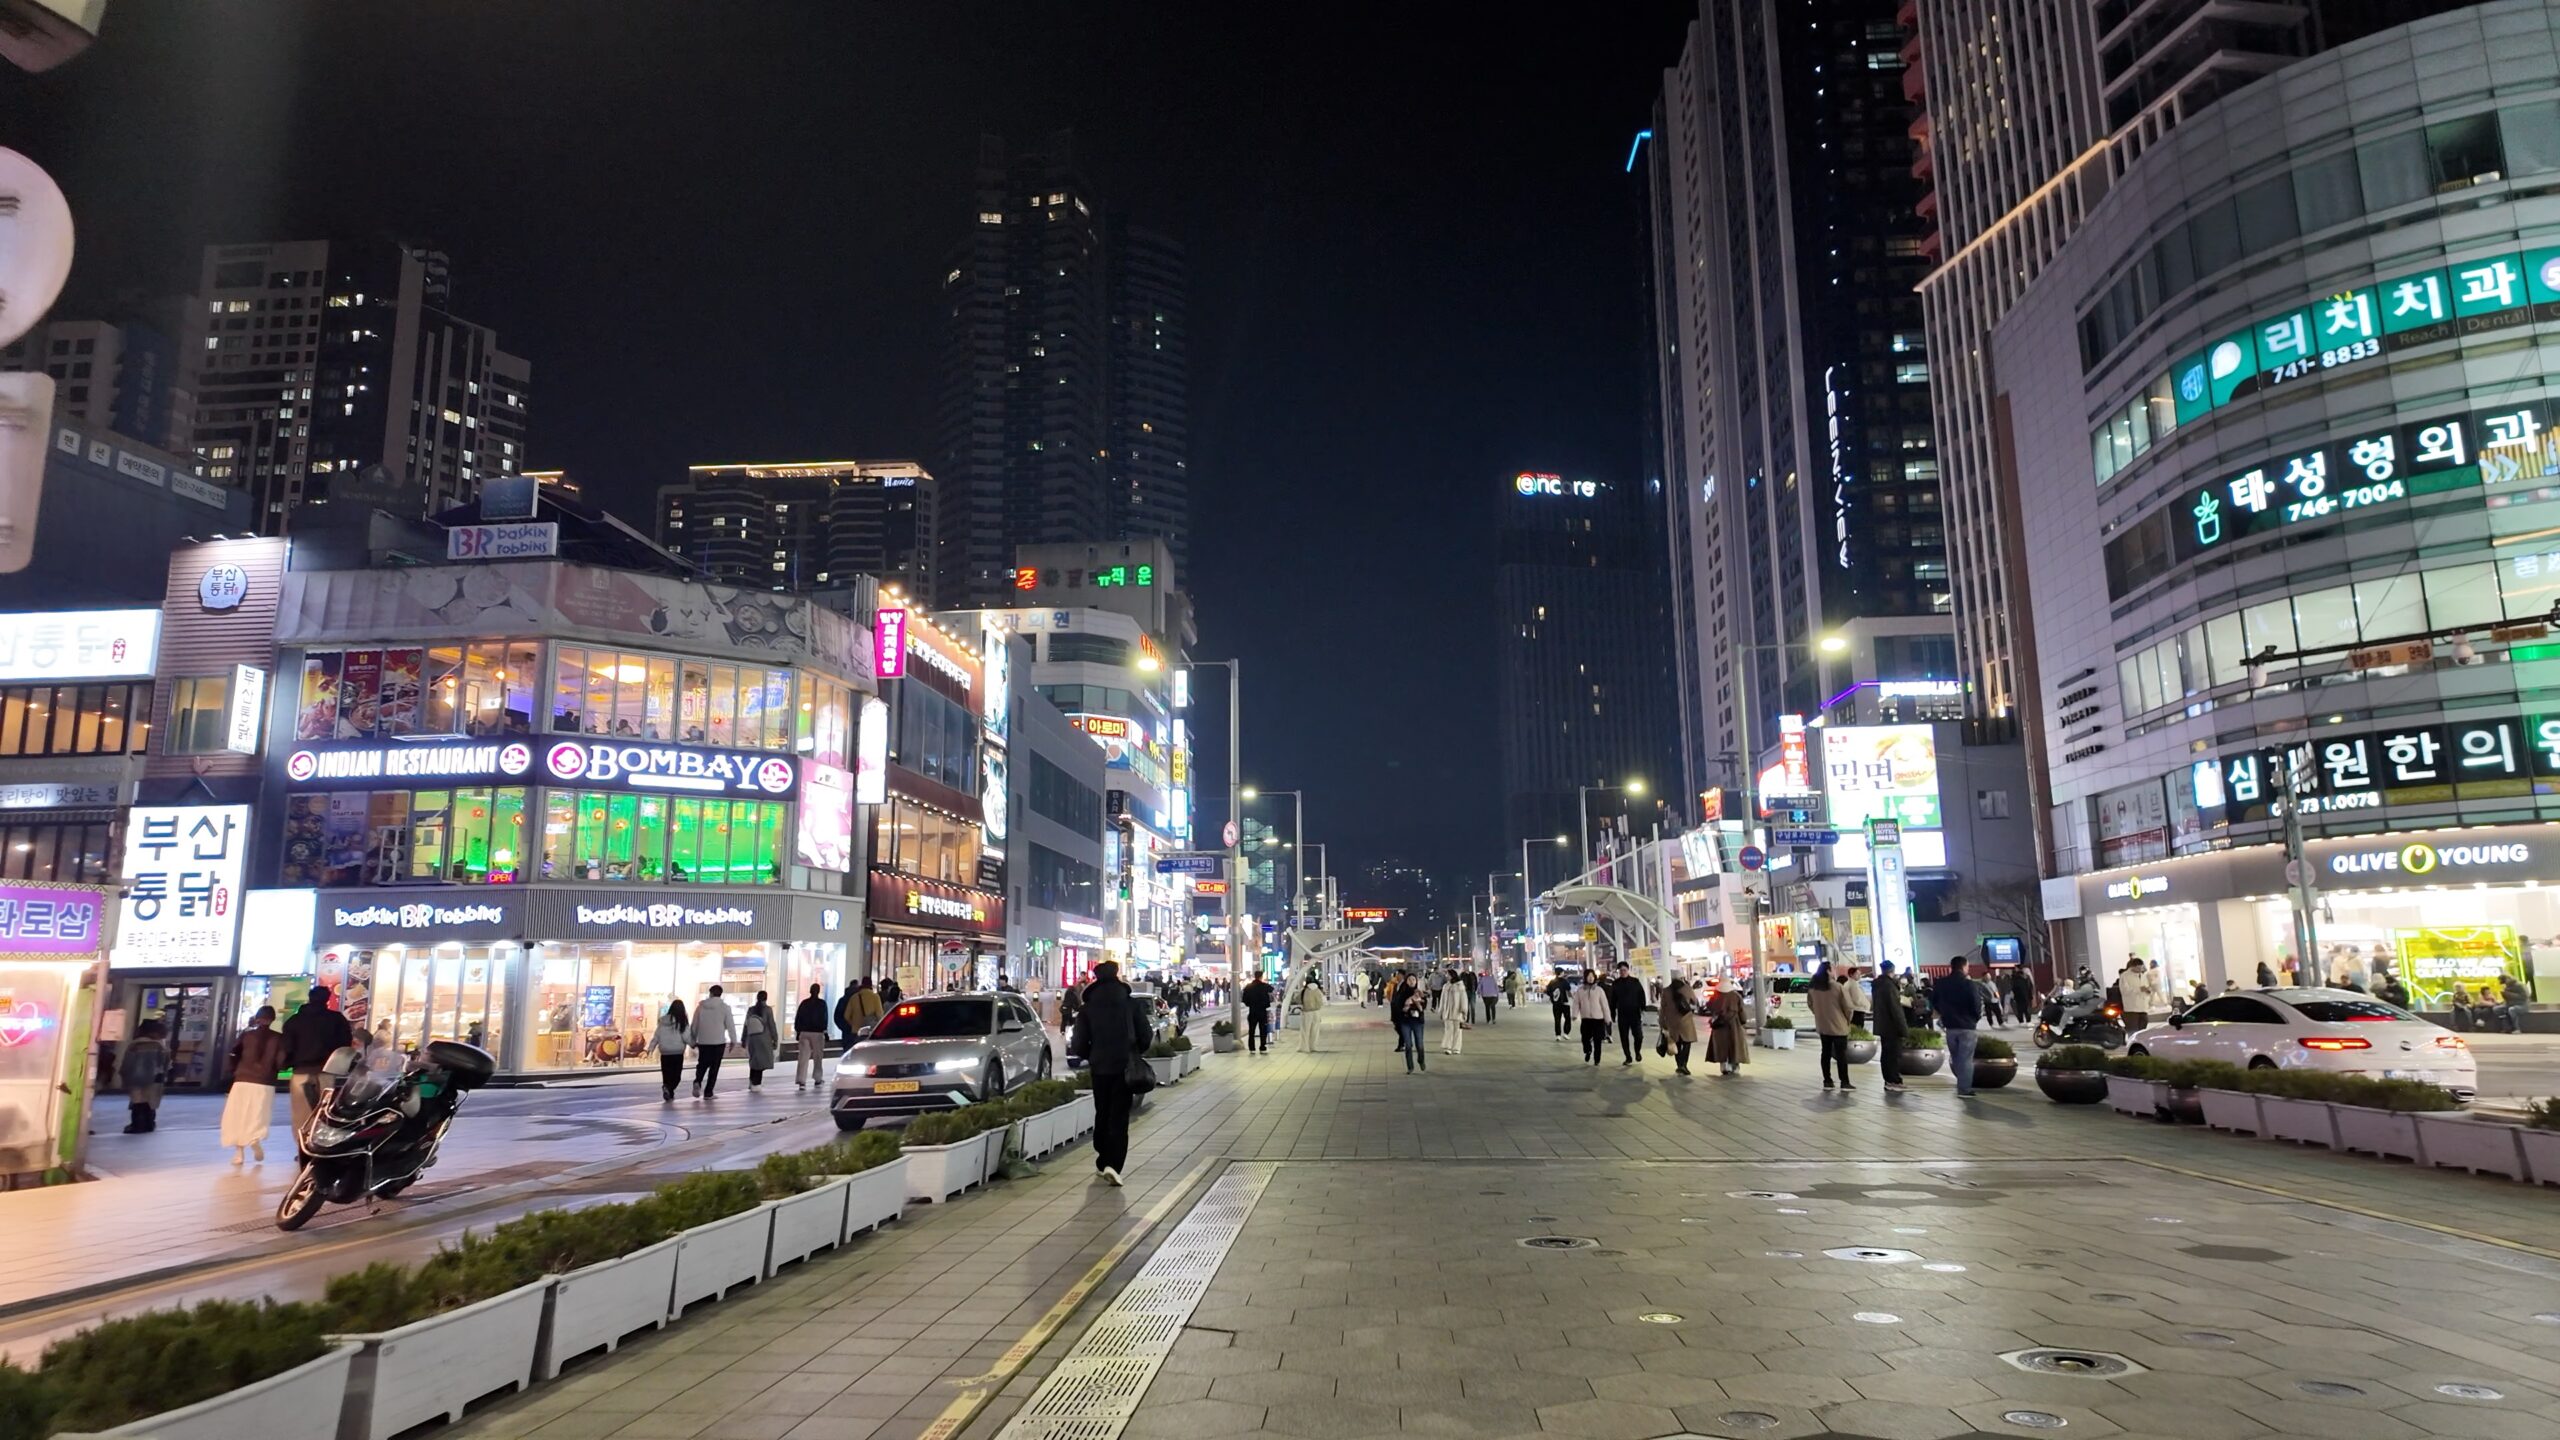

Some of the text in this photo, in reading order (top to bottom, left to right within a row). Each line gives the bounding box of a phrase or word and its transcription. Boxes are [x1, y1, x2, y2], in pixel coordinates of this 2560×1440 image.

[2264, 261, 2517, 356] 리치치과
[2466, 309, 2526, 331] Dental
[452, 525, 548, 556] BR baskin
[496, 542, 547, 556] robbins
[212, 568, 237, 582] 부산
[210, 582, 236, 597] 통닭
[1088, 719, 1125, 737] 아로마
[318, 746, 499, 778] INDIAN RESTAURANT
[585, 745, 762, 791] BOMBAY
[1831, 758, 1895, 792] 밀면
[1112, 791, 1121, 814] BAR
[138, 814, 236, 862] 부산
[2332, 843, 2529, 874] OLIVE YOUNG
[489, 873, 512, 883] OPEN
[129, 869, 221, 922] 통닭
[335, 904, 502, 928] baskin BR robbins
[577, 904, 753, 928] baskin BR robbins
[823, 909, 839, 931] BR
